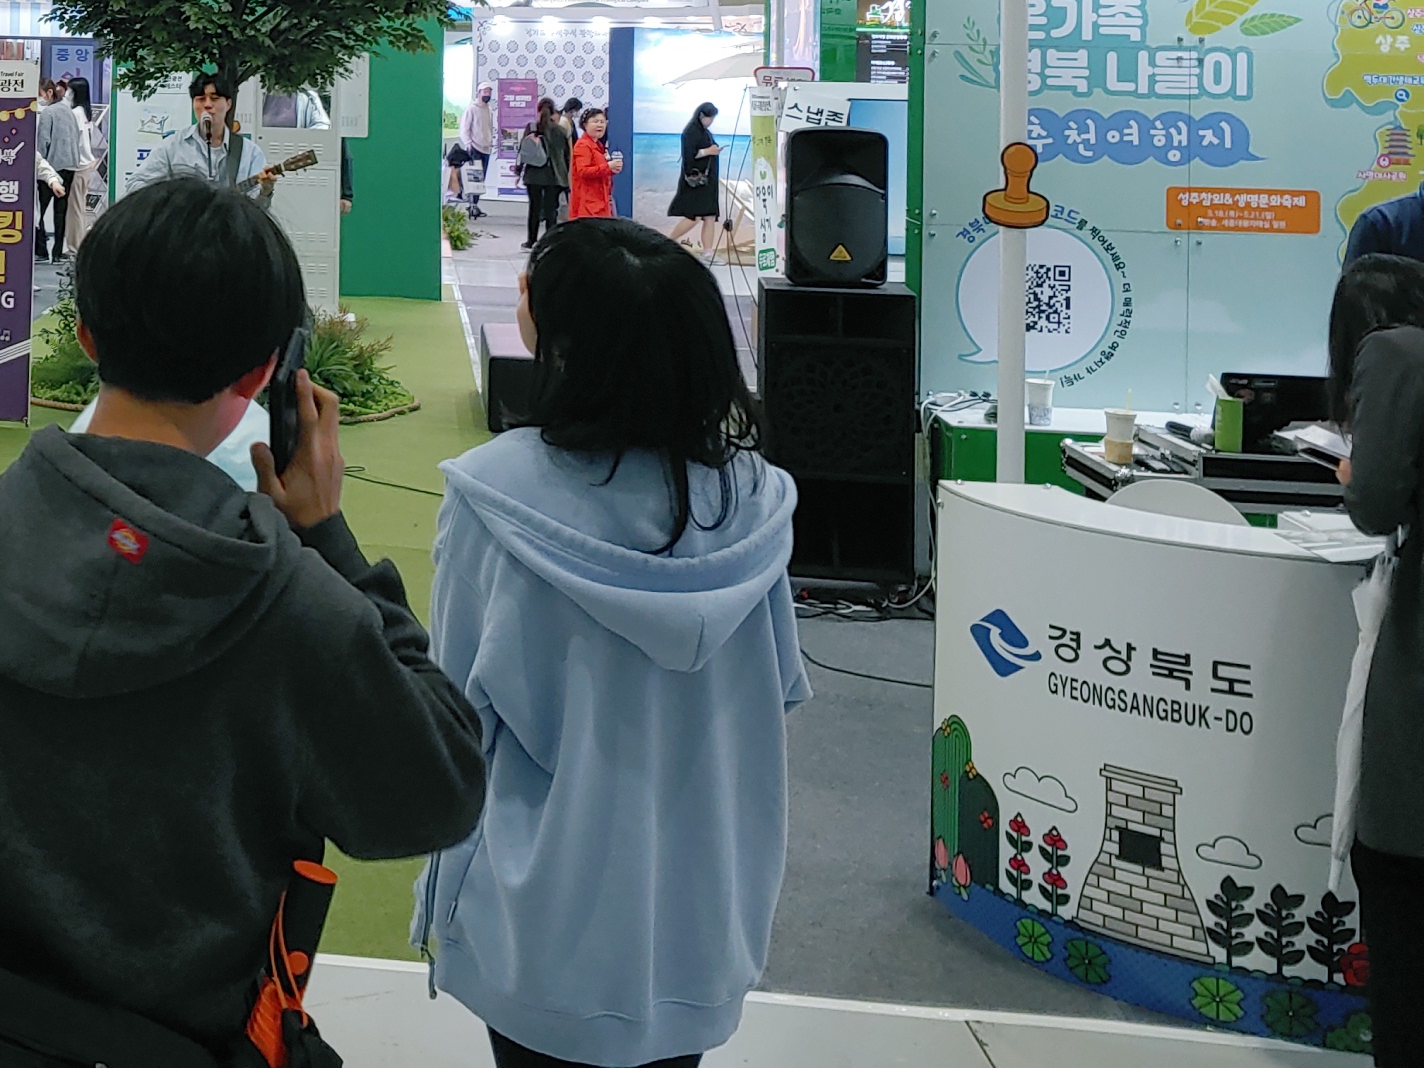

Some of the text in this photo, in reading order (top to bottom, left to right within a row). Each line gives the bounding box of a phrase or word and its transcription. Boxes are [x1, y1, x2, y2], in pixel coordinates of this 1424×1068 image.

[1376, 34, 1411, 54] 상주
[1106, 51, 1248, 97] 나들이
[1047, 623, 1254, 700] 경상북도
[1047, 671, 1255, 736] GYEONGSANGBUK-DO
